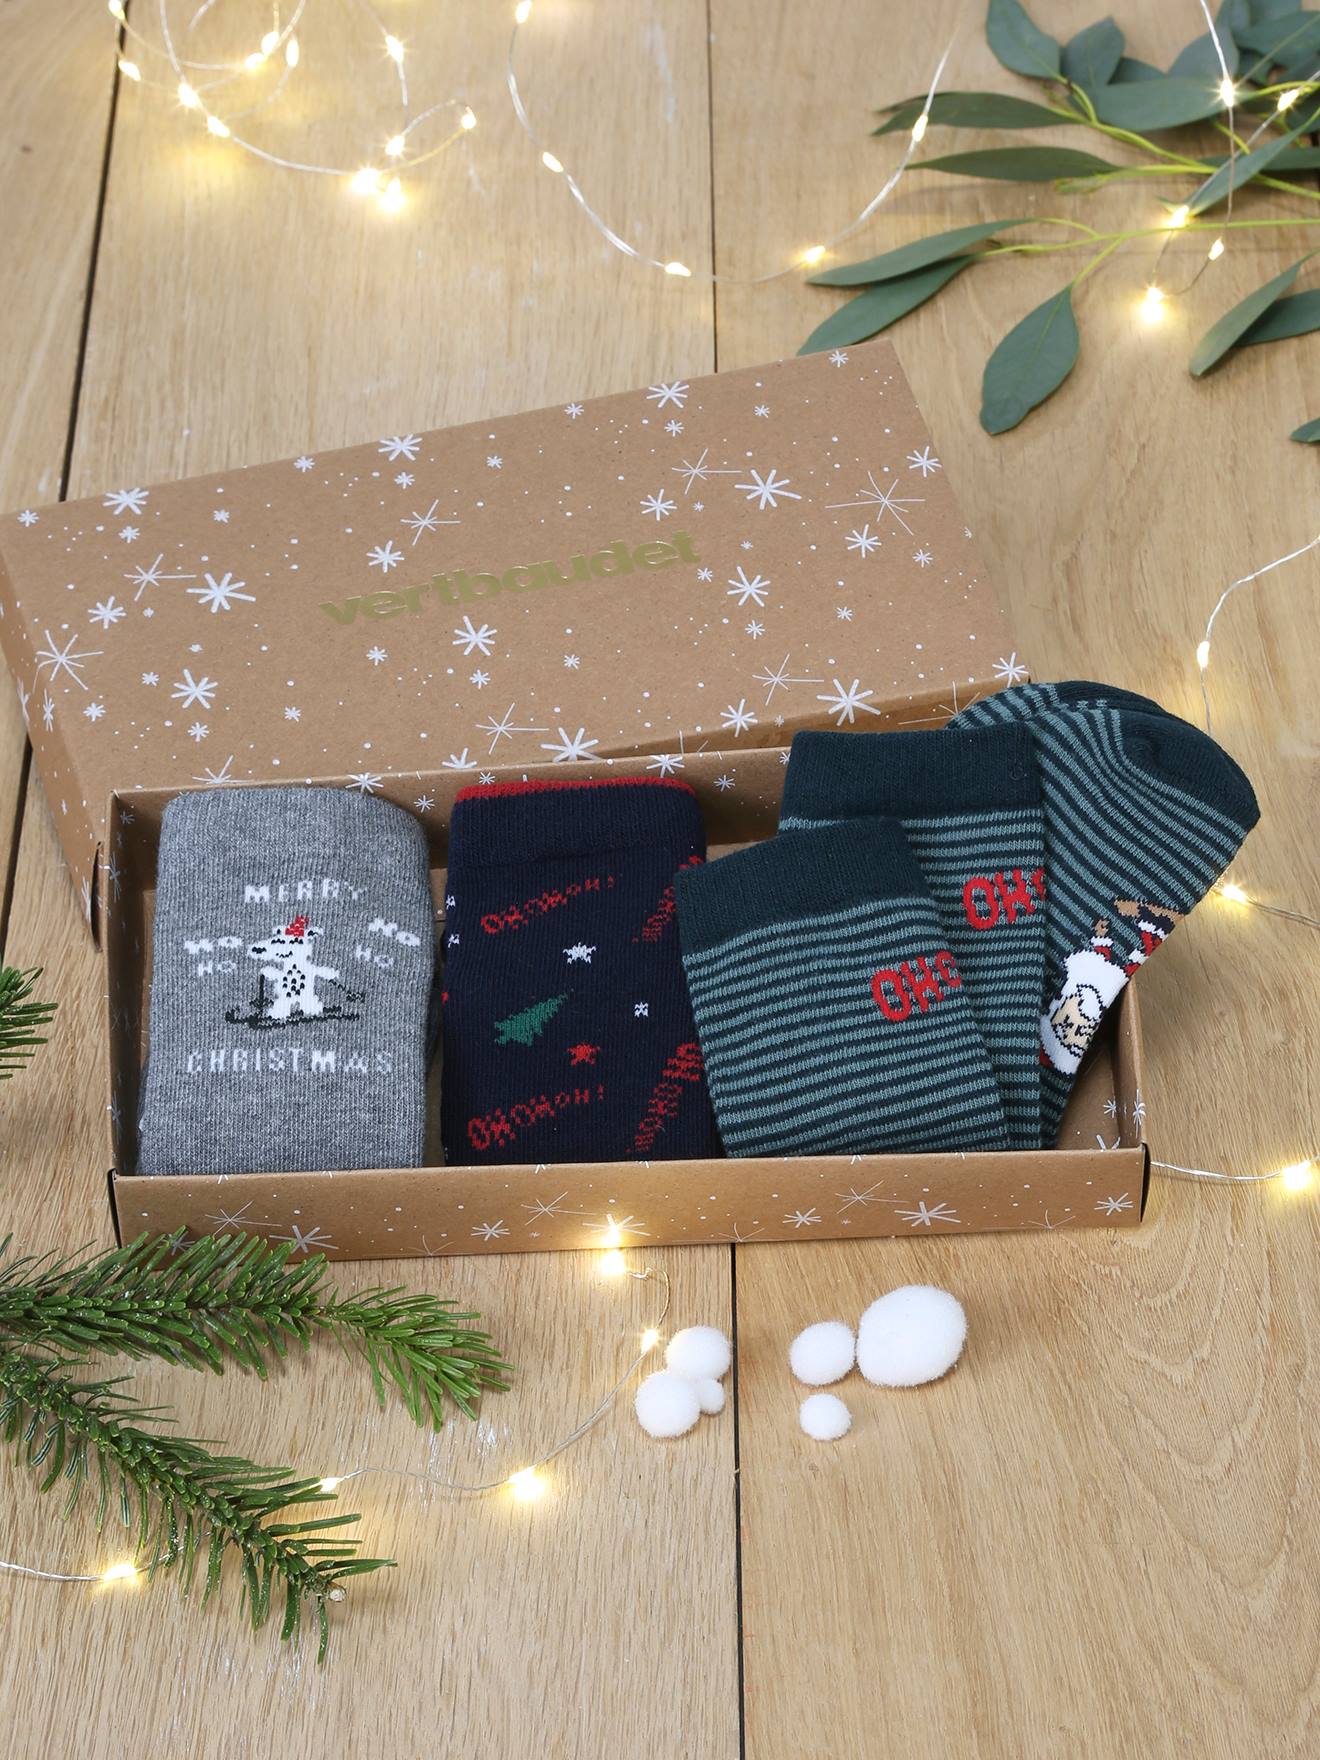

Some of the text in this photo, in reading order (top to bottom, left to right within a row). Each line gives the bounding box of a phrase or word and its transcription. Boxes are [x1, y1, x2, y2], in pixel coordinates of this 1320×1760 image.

[319, 530, 700, 625] vertbaudet
[244, 879, 367, 902] MERRY
[187, 1048, 392, 1073] CHRISTMAS
